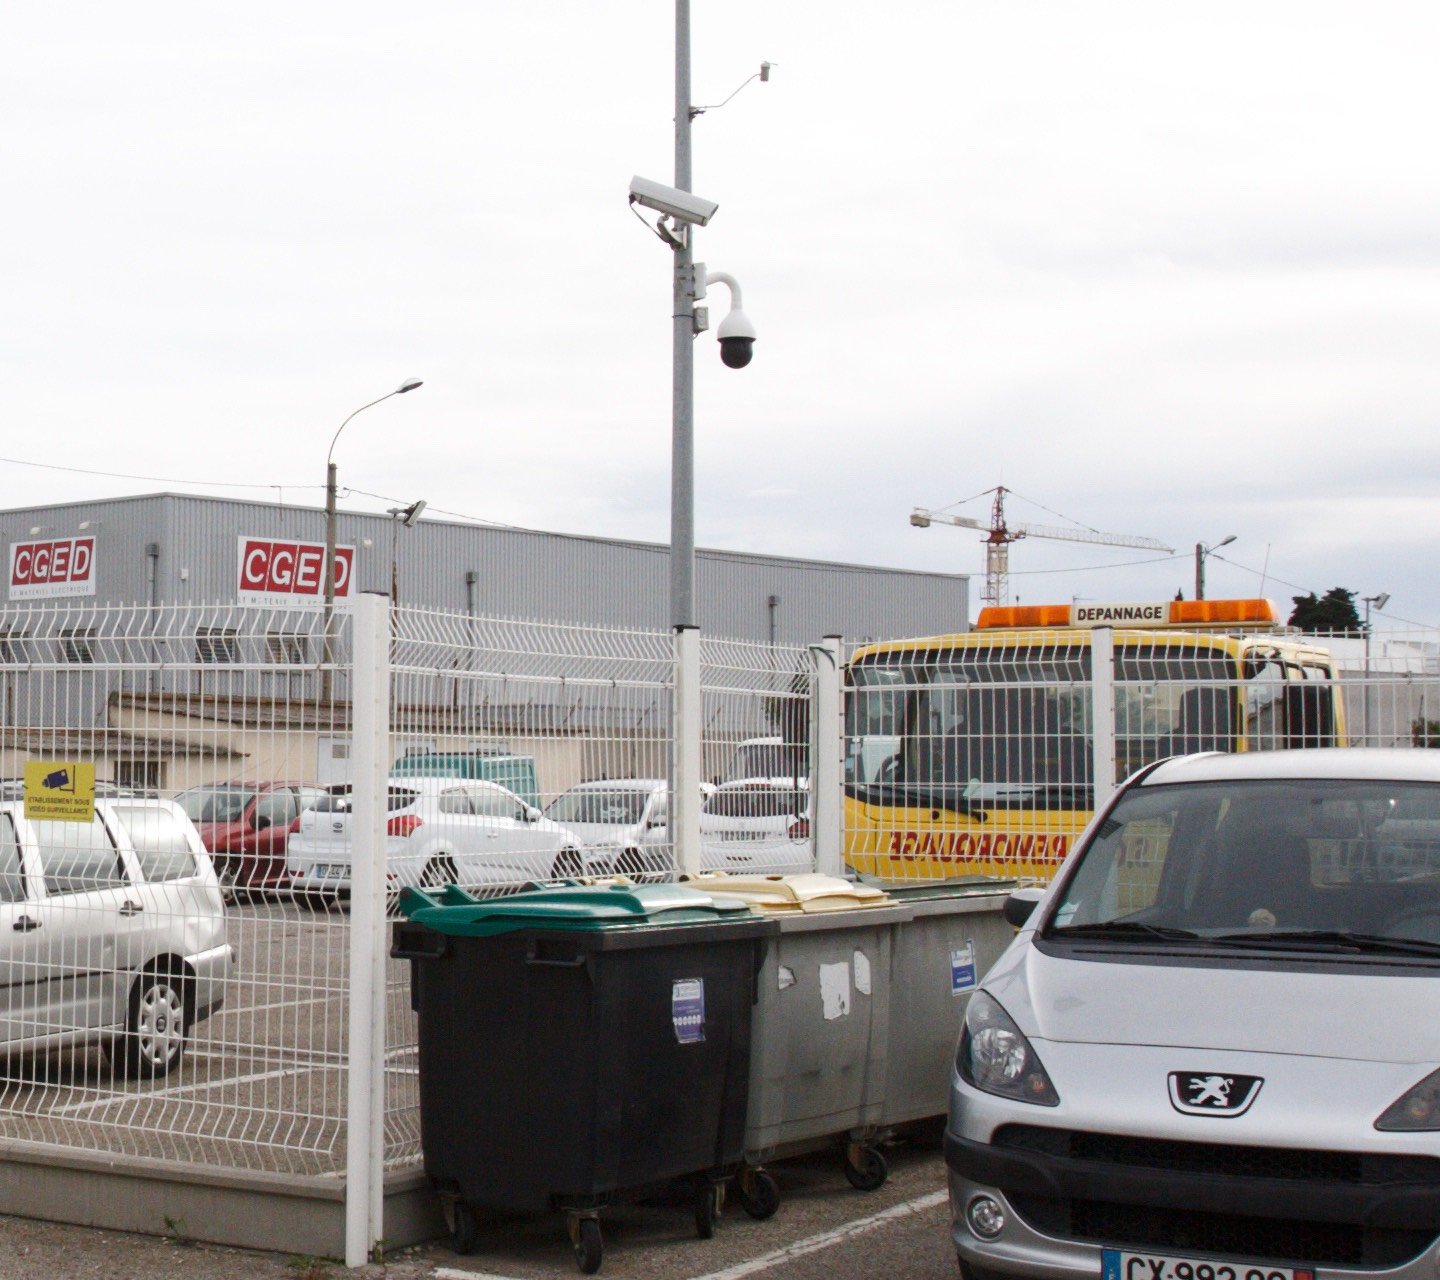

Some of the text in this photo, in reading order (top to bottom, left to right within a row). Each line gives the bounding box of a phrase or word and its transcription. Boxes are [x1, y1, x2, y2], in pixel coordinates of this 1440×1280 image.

[16, 546, 90, 579] CGED
[246, 549, 348, 589] CGED
[1077, 607, 1163, 621] DEPANNAGE
